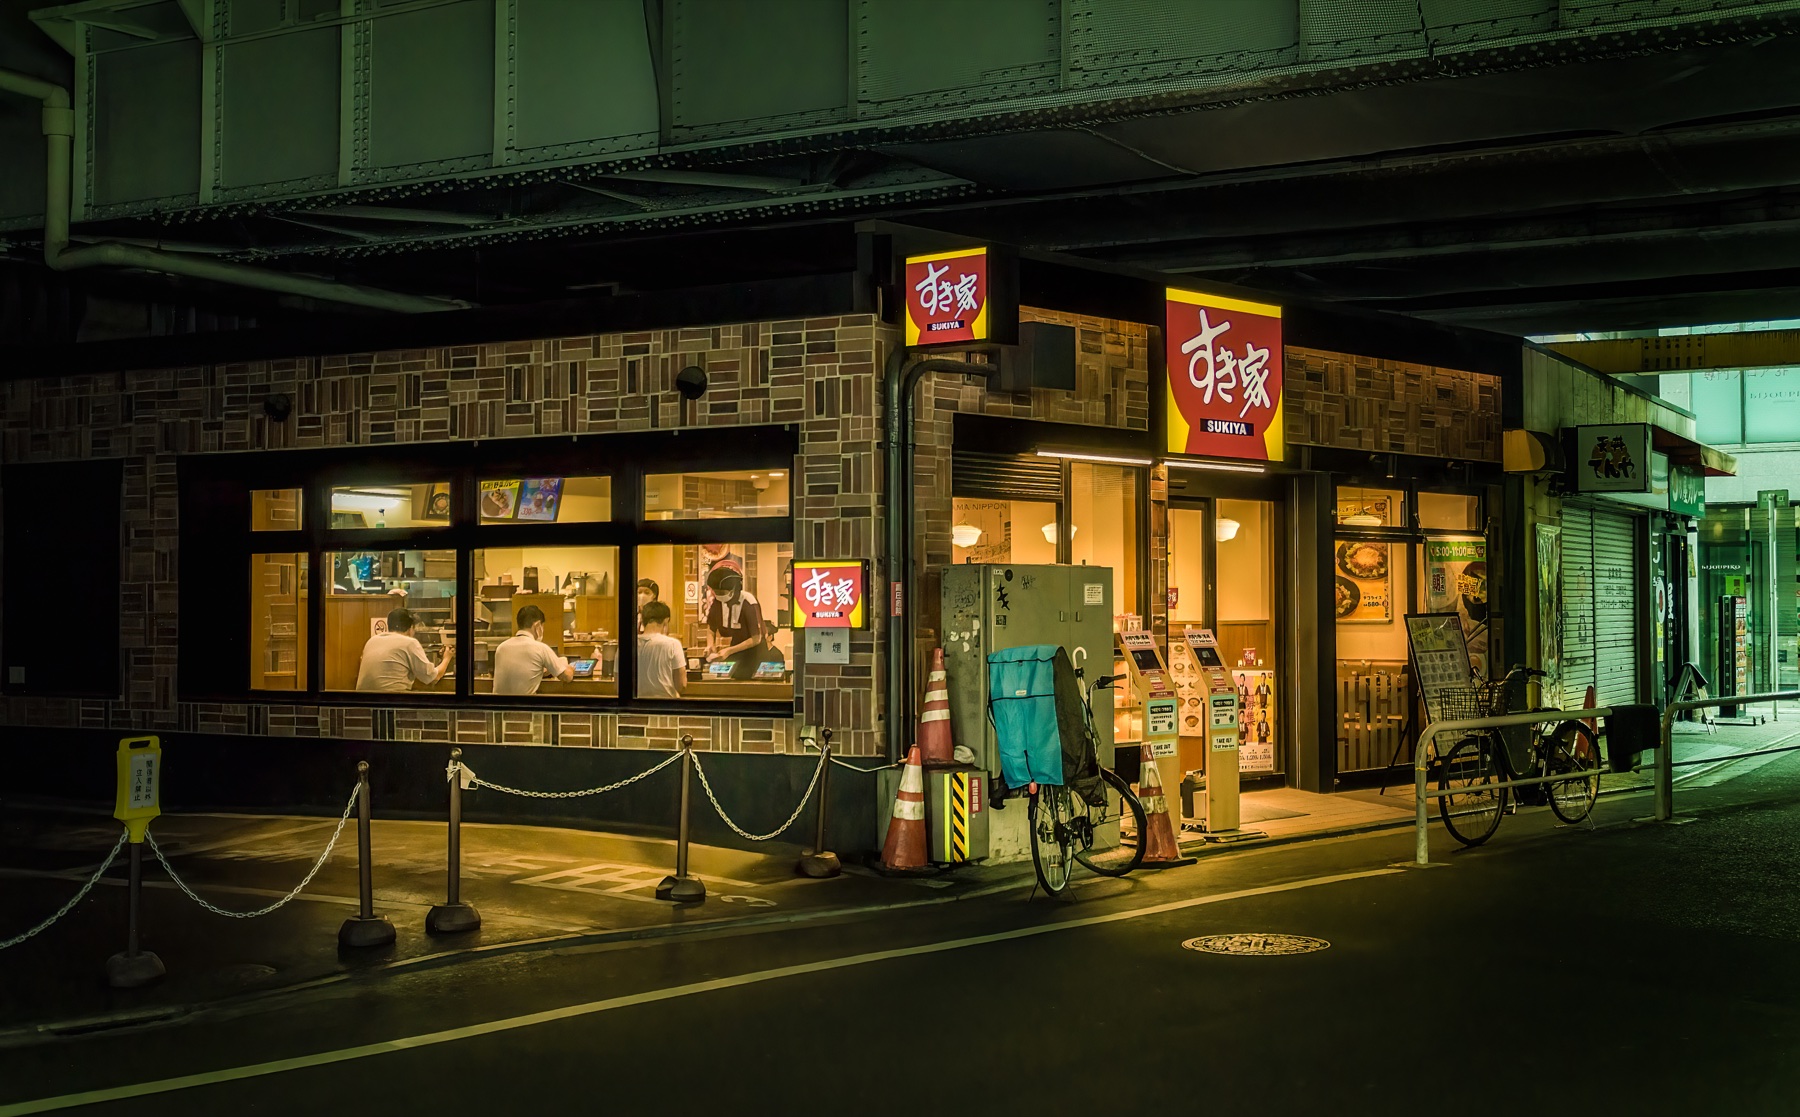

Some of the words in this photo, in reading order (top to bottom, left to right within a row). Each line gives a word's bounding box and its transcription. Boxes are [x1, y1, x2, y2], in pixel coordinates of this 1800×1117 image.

[914, 262, 978, 319] すき家
[931, 320, 960, 331] SUKIYA
[1181, 308, 1271, 418] すき家
[1206, 419, 1248, 436] SUKIYA
[972, 502, 1007, 510] NIPPON
[801, 567, 854, 611] すき家
[814, 642, 842, 653] 禁煙
[134, 769, 143, 801] 立入禁止
